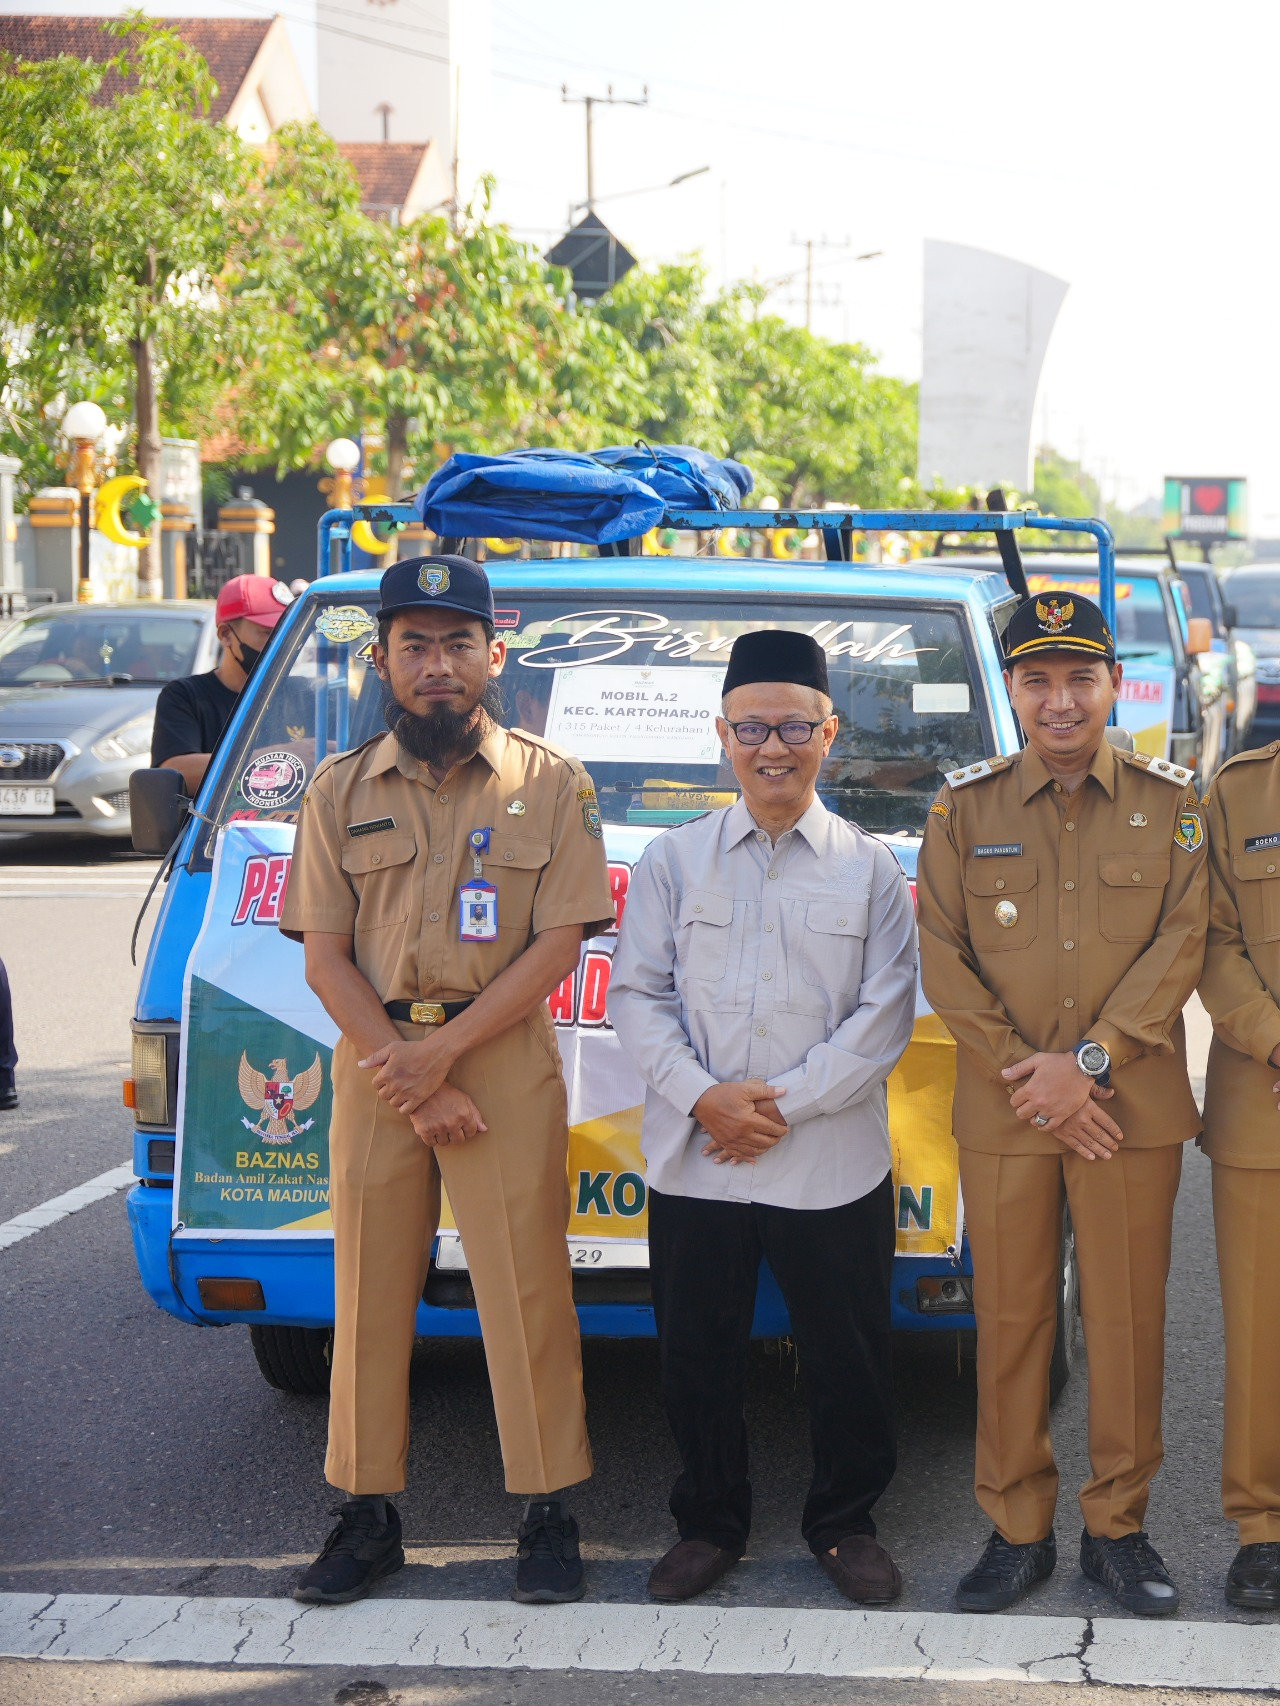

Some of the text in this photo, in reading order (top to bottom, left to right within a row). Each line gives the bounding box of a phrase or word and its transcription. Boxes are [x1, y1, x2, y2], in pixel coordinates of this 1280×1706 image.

[601, 691, 679, 702] MOBIL A.2
[563, 706, 710, 719] KEC. KARTOHARJO
[590, 722, 621, 731] Paket
[645, 724, 703, 734] Kelurahan
[254, 753, 302, 771] MUATAN TRUCK
[247, 794, 288, 808] INDONESIA
[1255, 837, 1279, 846] SOEKO
[235, 1151, 319, 1169] BAZNAS
[195, 1172, 233, 1183] Badan
[235, 1173, 265, 1184] Amil
[267, 1173, 303, 1185] Zakat
[220, 1188, 330, 1203] KOTA MADIUN
